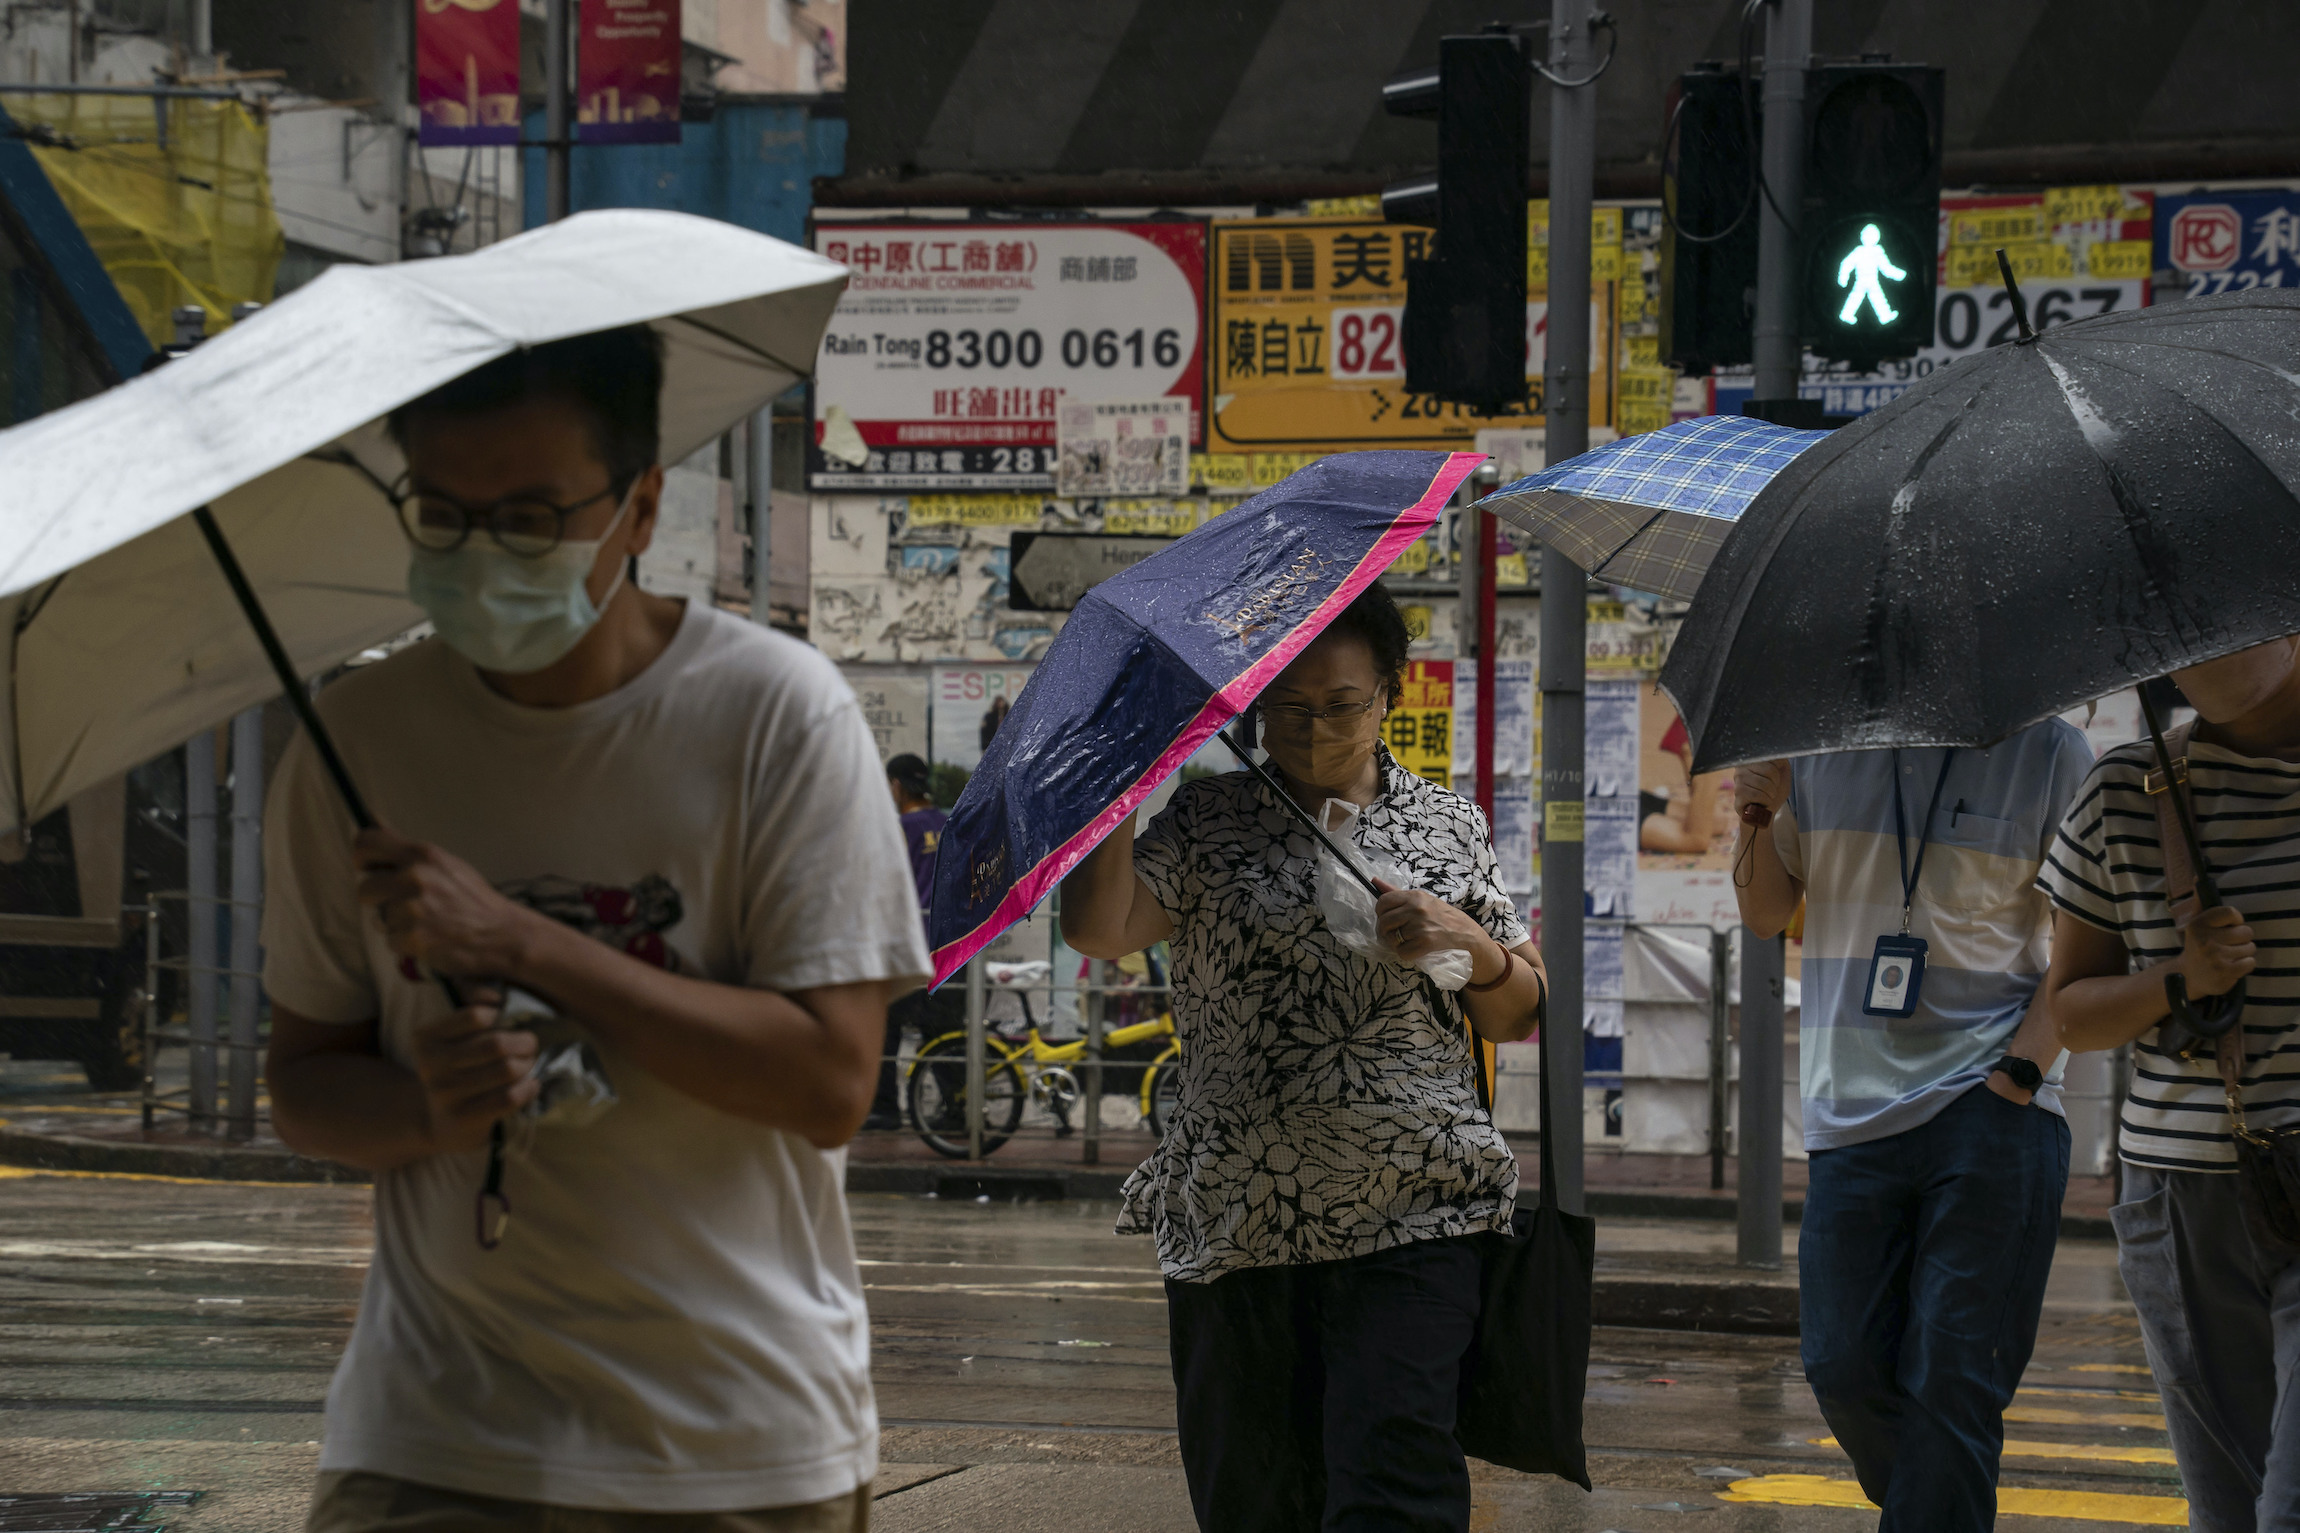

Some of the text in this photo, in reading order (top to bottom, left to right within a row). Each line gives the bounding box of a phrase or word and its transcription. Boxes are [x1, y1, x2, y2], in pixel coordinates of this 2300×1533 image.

[936, 275, 1035, 290] COMMERCIAL
[825, 328, 1181, 368] Rain Tong 8300 0616
[1227, 316, 1325, 379] 陳自立
[1338, 313, 1406, 373] 82
